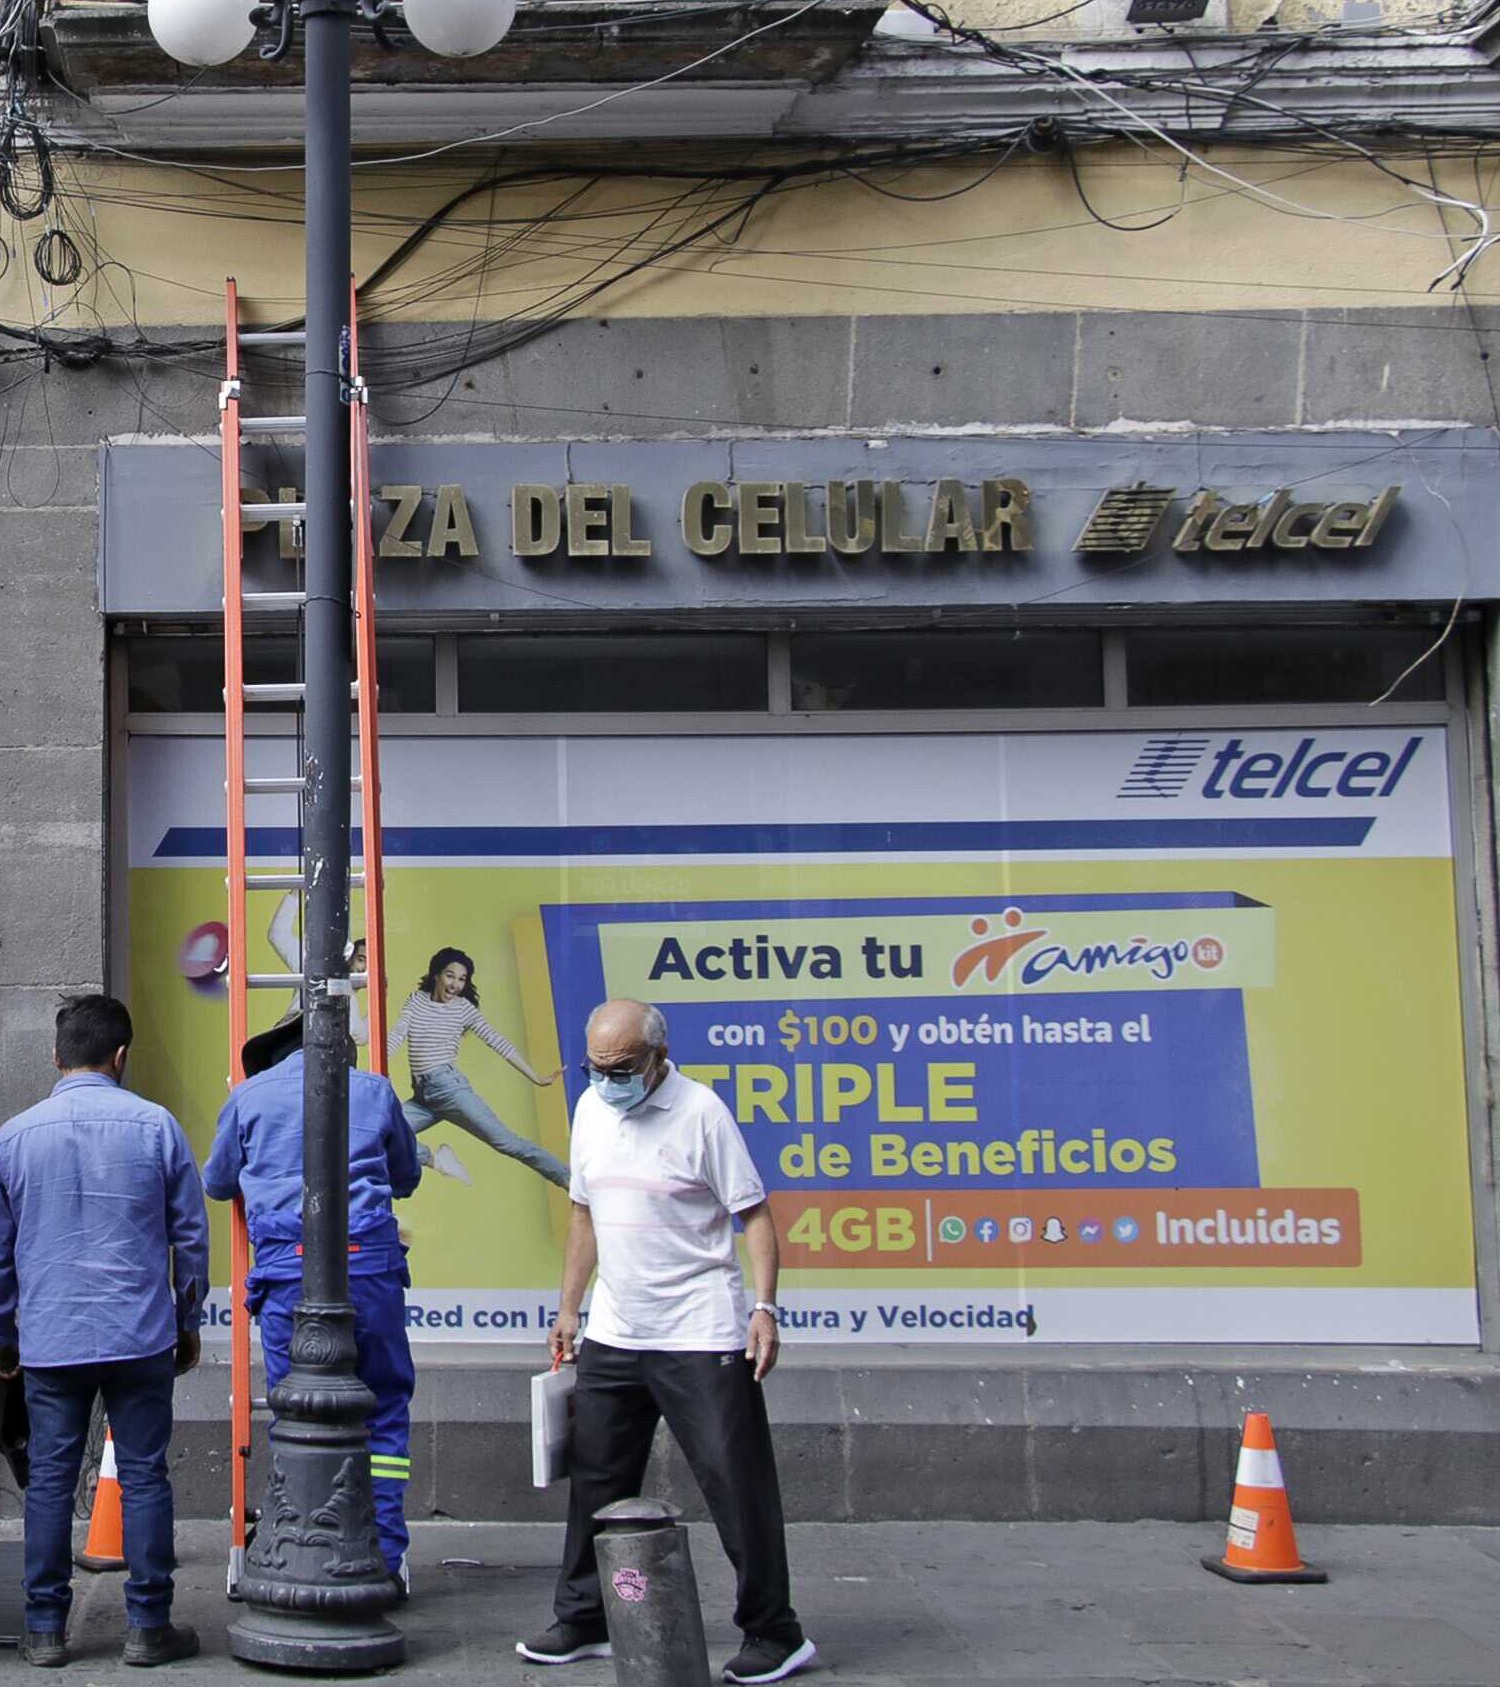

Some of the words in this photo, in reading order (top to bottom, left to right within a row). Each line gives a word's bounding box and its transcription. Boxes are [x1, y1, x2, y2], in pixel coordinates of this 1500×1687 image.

[240, 485, 478, 558] LZA
[512, 484, 651, 557] DEL
[681, 479, 1033, 556] CELULAR
[1173, 485, 1401, 552] telcel
[1202, 737, 1424, 798] telcel
[648, 935, 842, 980] Activa
[862, 937, 923, 979] tu
[1021, 937, 1189, 986] amigo
[1197, 943, 1220, 961] kit
[708, 1023, 766, 1047] con
[777, 1009, 879, 1053] $100
[888, 1023, 911, 1053] y
[918, 1013, 1014, 1045] obtén
[1022, 1015, 1114, 1045] hasta
[1121, 1014, 1152, 1044] el
[678, 1062, 978, 1124] TRIPLE
[779, 1134, 852, 1178] de
[870, 1129, 1177, 1177] Beneficios
[787, 1205, 916, 1252] 4GB
[1155, 1208, 1342, 1245] Incluidas
[407, 1305, 462, 1328] Red
[474, 1310, 528, 1328] con
[850, 1309, 868, 1332] y
[877, 1304, 1034, 1328] Velocidad
